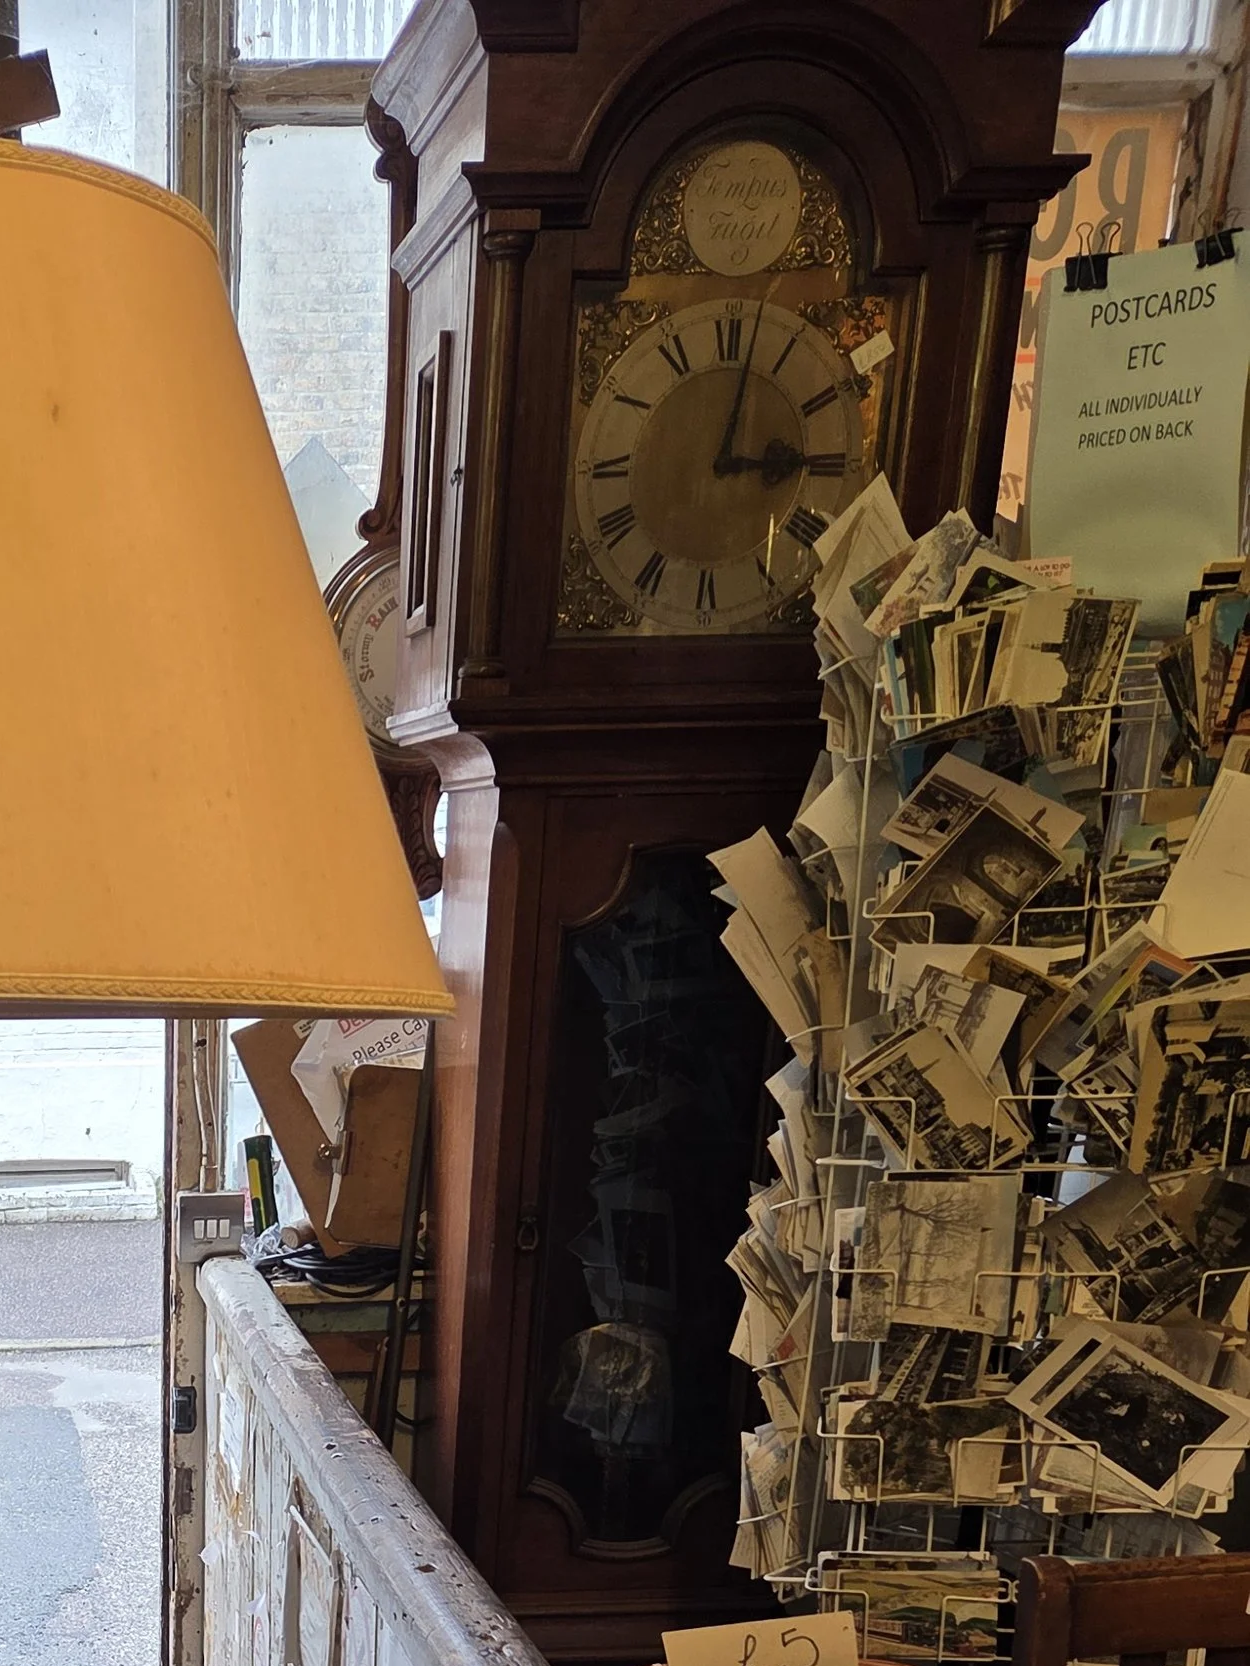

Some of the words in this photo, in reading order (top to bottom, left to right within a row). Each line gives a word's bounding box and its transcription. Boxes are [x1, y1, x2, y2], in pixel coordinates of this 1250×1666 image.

[696, 158, 787, 210] Tempus
[1090, 283, 1217, 329] POSTCARDS
[1127, 342, 1166, 370] ETC
[1078, 401, 1101, 418] ALL
[1105, 386, 1203, 416] INDIVIDUALLY
[1078, 427, 1126, 449] PRICED
[1130, 424, 1151, 443] ON
[1156, 420, 1194, 440] BACK
[366, 600, 398, 632] RAIN
[359, 634, 375, 685] Stormy
[352, 1032, 401, 1060] Please
